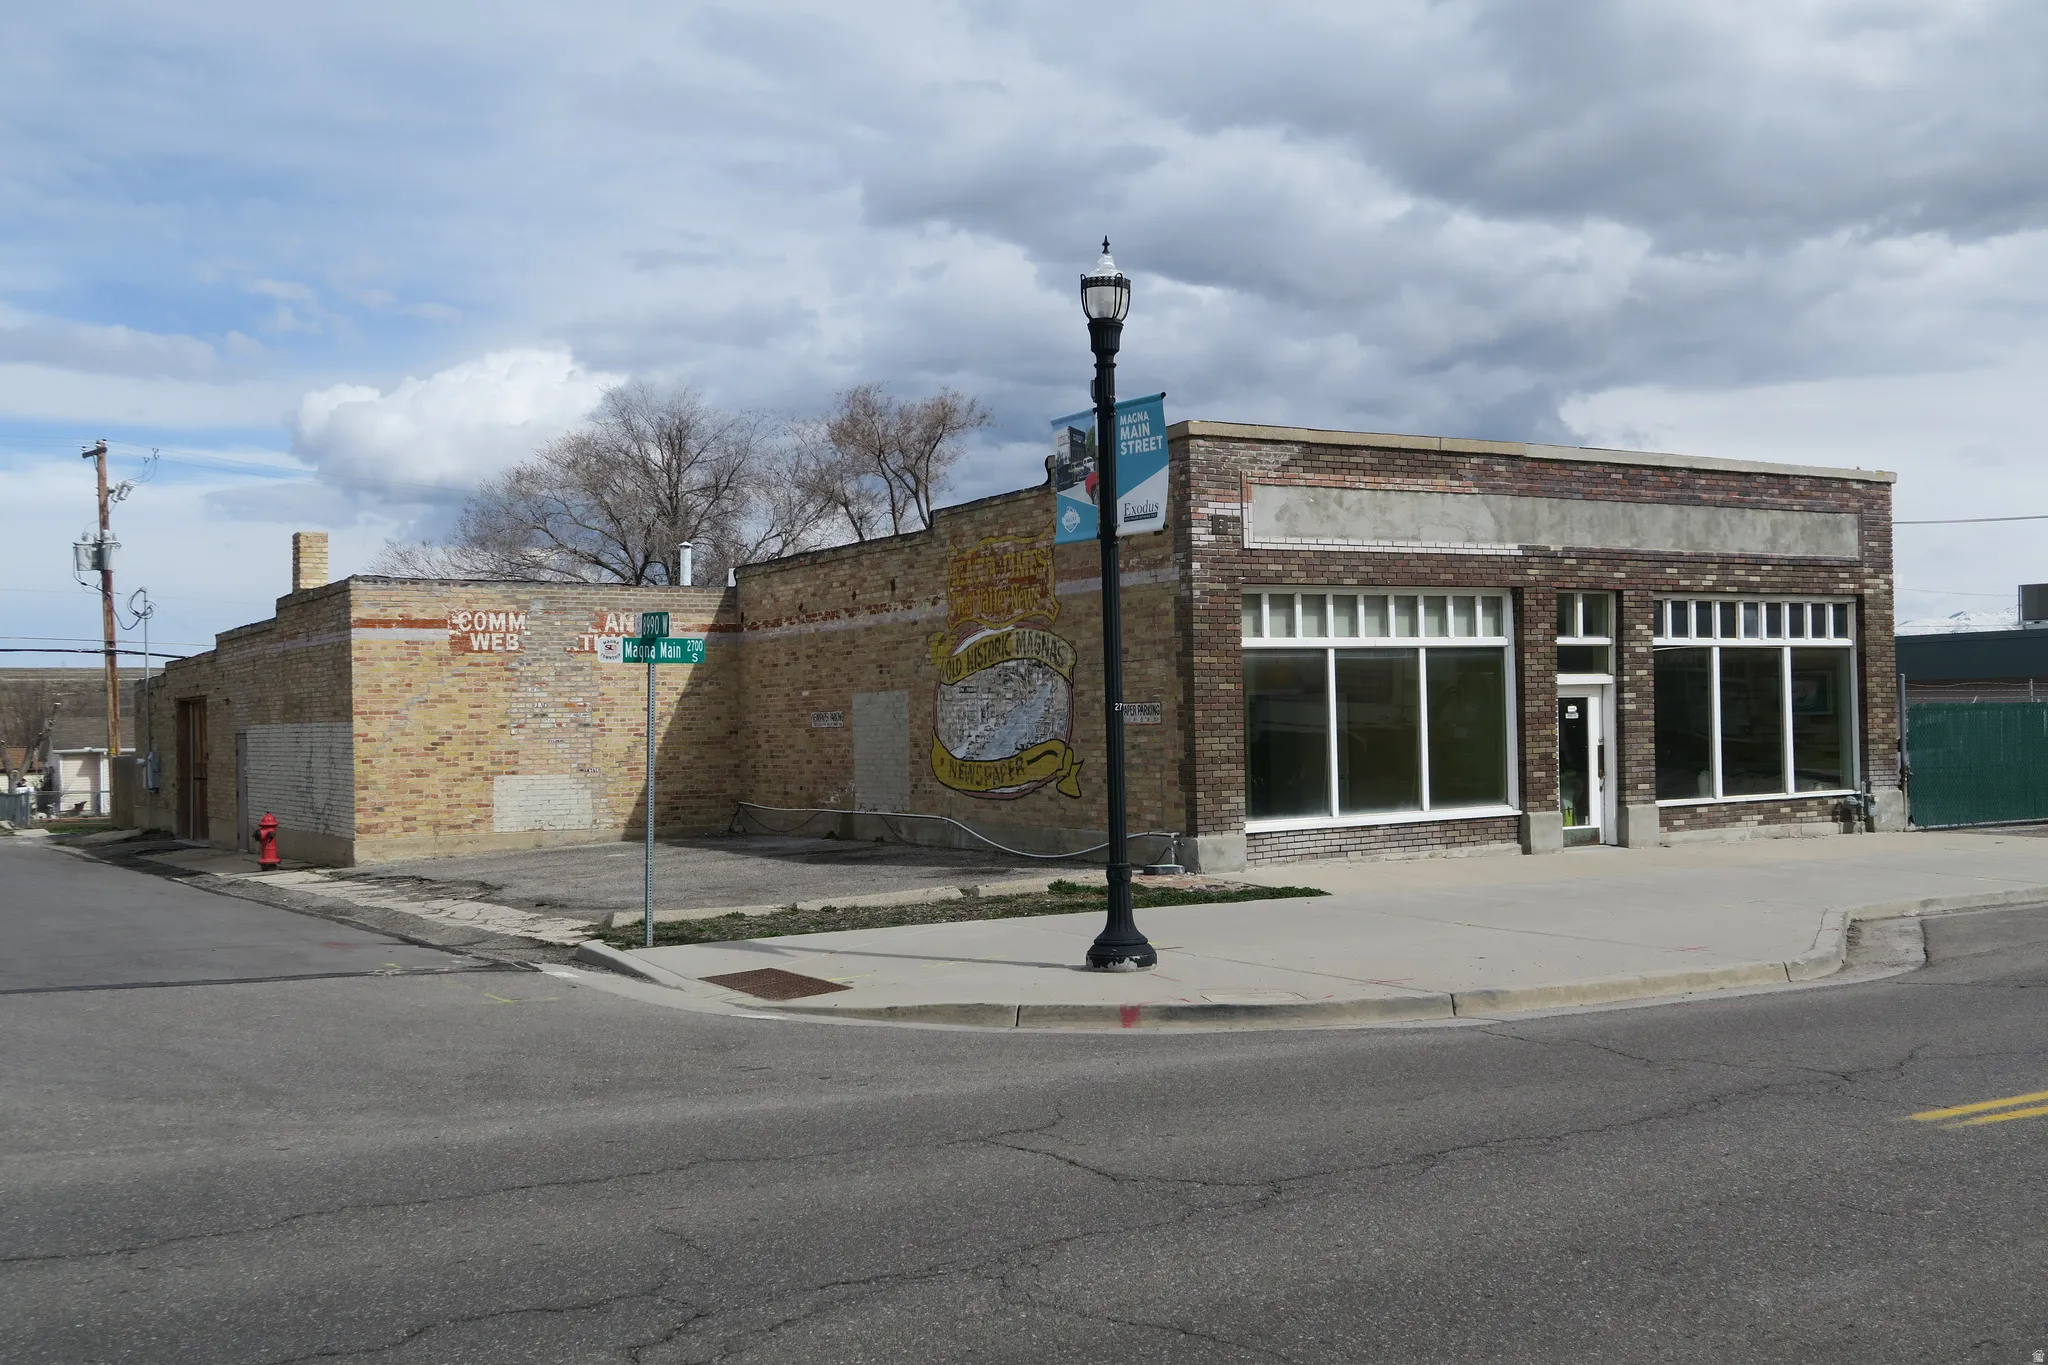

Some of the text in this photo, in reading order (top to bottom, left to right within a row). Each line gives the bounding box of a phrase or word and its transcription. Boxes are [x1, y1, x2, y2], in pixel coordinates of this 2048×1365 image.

[1120, 411, 1150, 425] MAGNA
[1120, 424, 1150, 440] MAIN
[1120, 435, 1163, 456] STREET
[1124, 500, 1159, 516] Exodus
[643, 615, 660, 636] 8990
[662, 614, 669, 635] W
[469, 632, 520, 651] WEB
[625, 639, 704, 663] Magna Main 2700
[691, 652, 699, 663] S
[946, 658, 962, 681] OLD
[966, 632, 1012, 673] HISTORIC
[1137, 704, 1160, 716] PARKING
[949, 756, 1025, 787] NEWSPAPER
